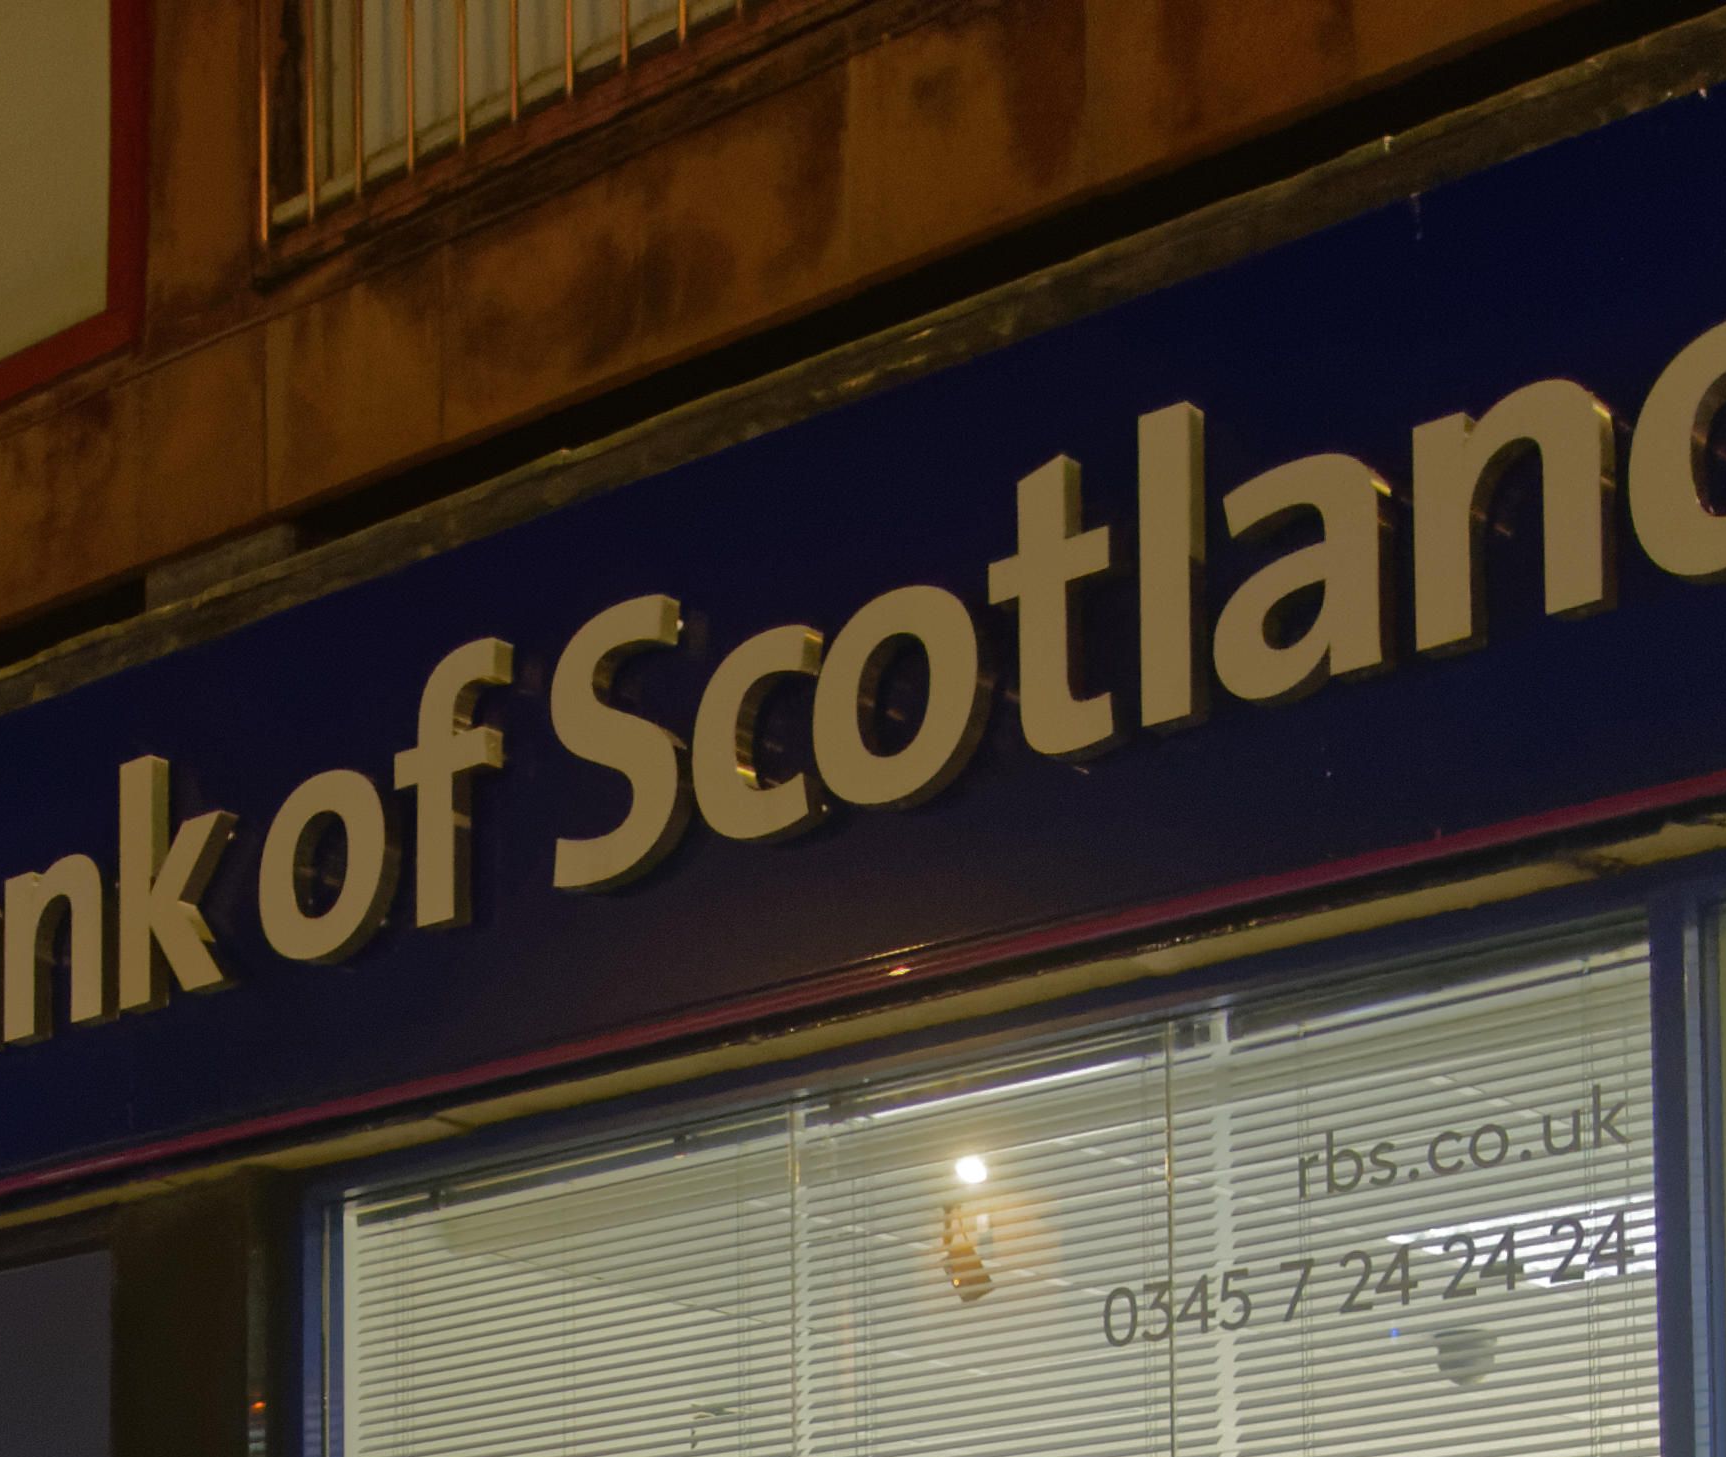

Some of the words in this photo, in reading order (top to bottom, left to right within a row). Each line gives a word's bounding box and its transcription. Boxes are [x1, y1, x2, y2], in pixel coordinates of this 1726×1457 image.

[258, 636, 515, 963] of
[1297, 1083, 1632, 1200] rbs.co.uk
[1103, 1267, 1252, 1347] 0345
[1280, 1257, 1315, 1322] 7
[1339, 1244, 1418, 1315] 24
[1442, 1226, 1525, 1299] 24
[1549, 1211, 1635, 1284] 24
